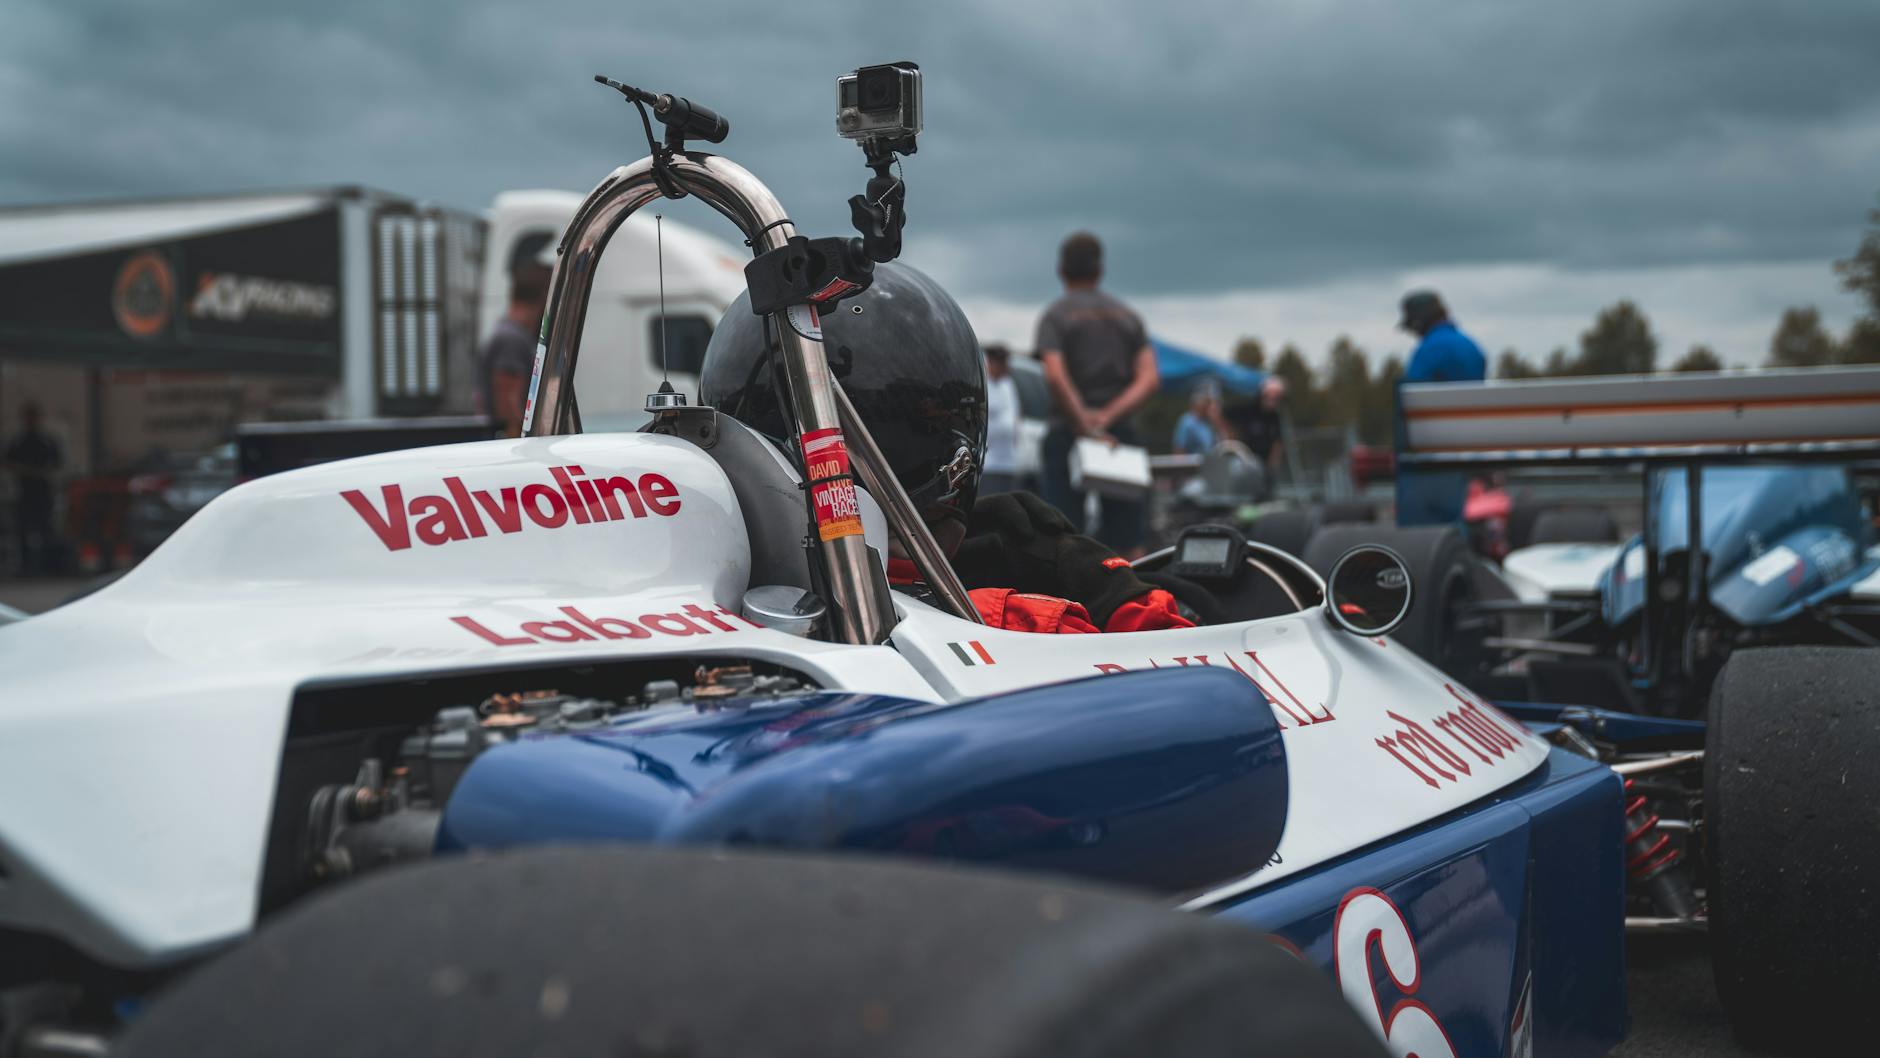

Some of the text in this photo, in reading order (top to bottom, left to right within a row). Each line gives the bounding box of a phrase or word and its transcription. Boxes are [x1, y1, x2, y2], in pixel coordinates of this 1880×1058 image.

[809, 460, 841, 480] DAVID
[339, 465, 681, 552] Valvoline
[815, 486, 855, 508] VINTAGE
[1374, 710, 1472, 790] red
